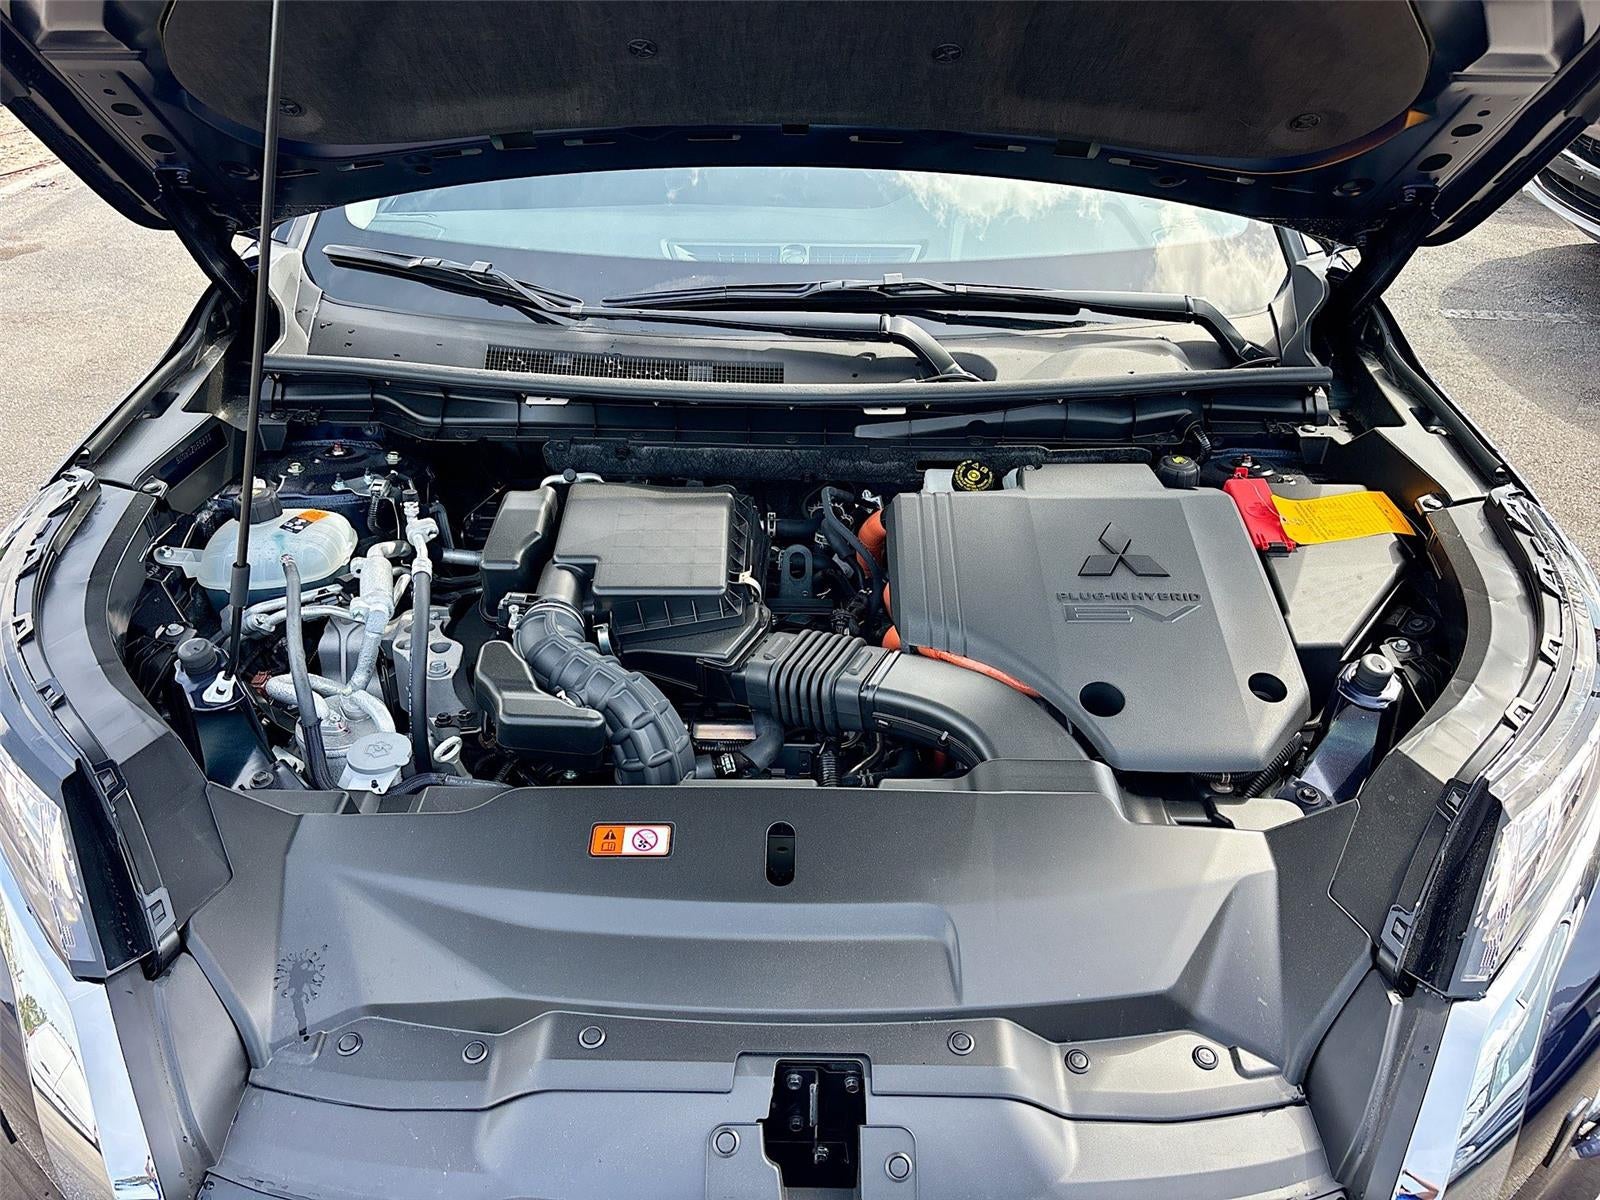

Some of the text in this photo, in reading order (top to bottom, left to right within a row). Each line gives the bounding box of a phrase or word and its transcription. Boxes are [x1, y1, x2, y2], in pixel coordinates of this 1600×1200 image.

[1056, 592, 1201, 601] PLUG-IN HYBRID
[1063, 603, 1201, 625] EV
